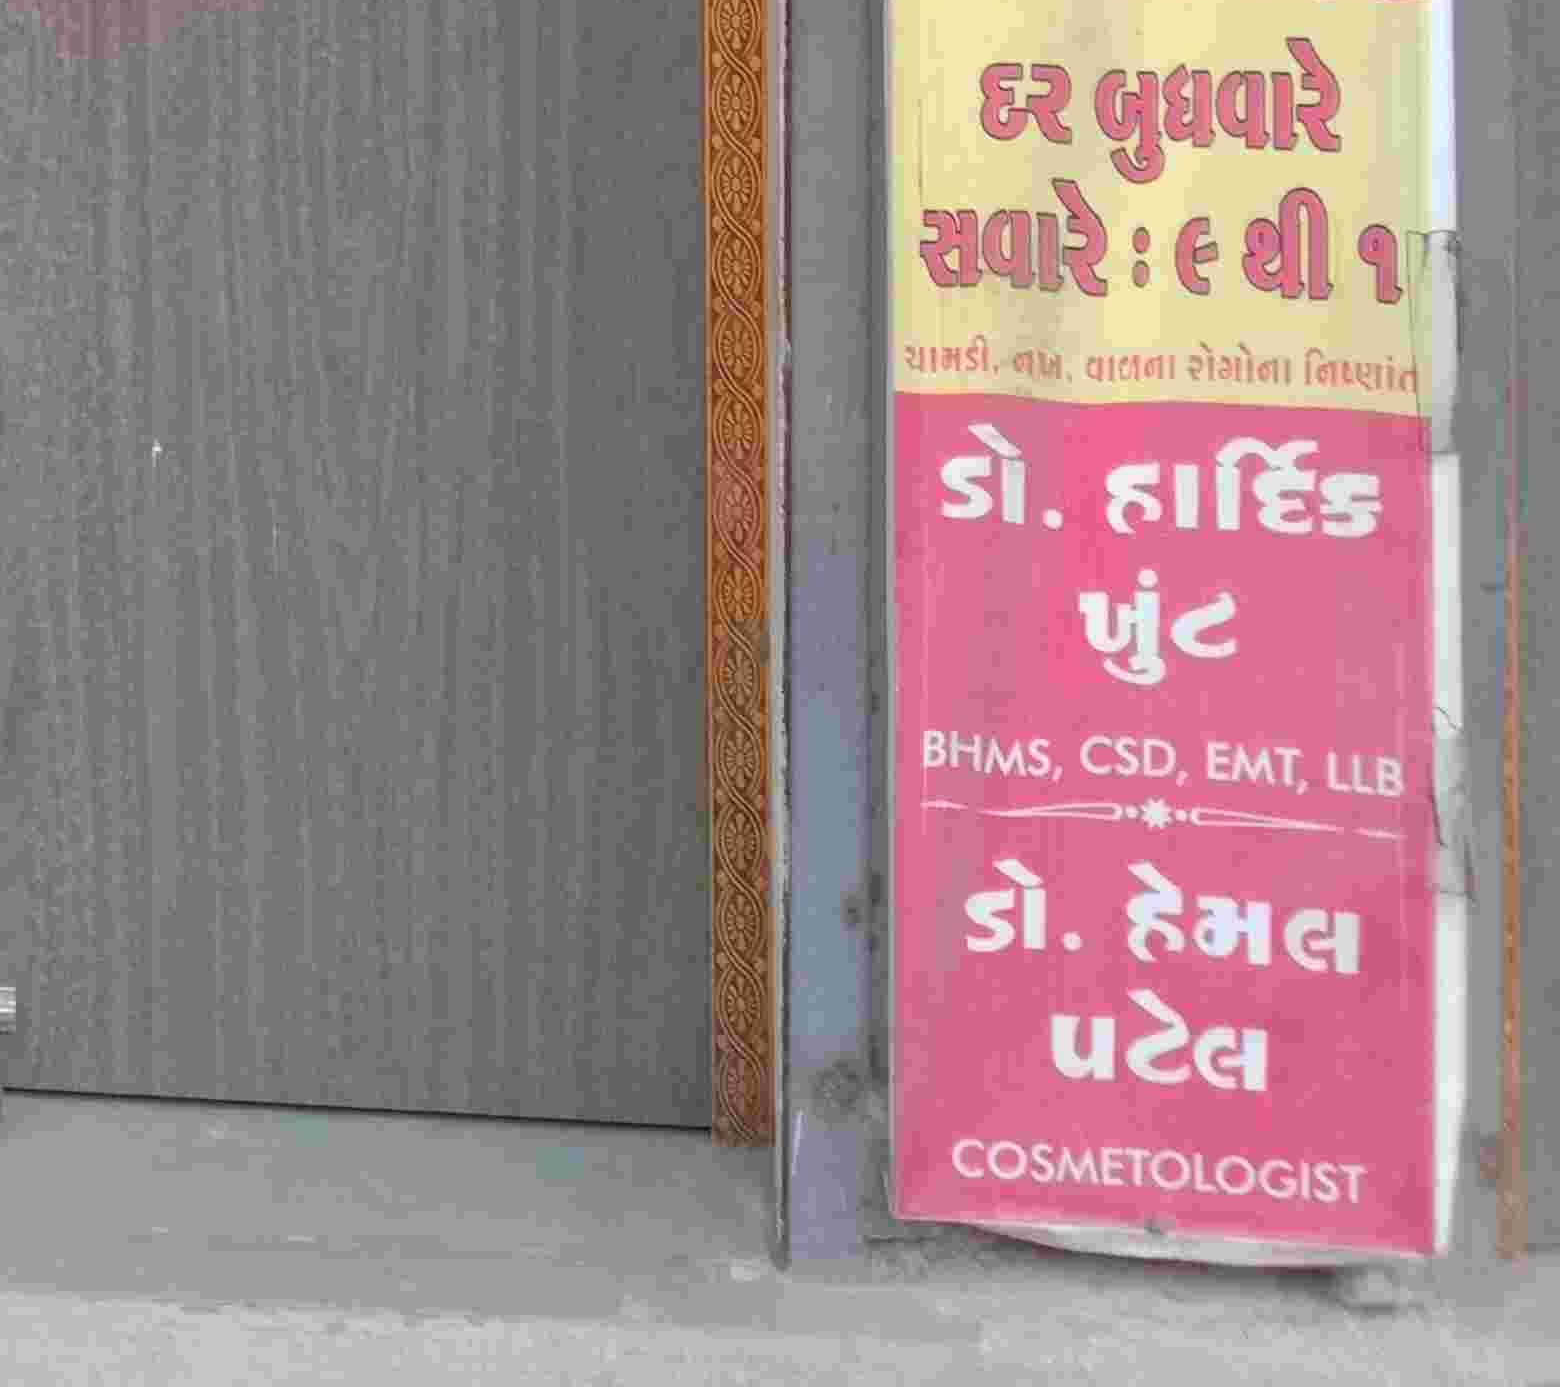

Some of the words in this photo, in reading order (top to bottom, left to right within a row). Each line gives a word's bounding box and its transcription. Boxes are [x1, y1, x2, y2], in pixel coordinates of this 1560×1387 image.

[979, 62, 1073, 145] દર
[1094, 36, 1343, 184] બુધવારે
[1241, 186, 1334, 301] થી
[1357, 223, 1404, 305] ૧
[939, 423, 1064, 529] ડો.
[1105, 436, 1383, 538] હાર્દિક
[1077, 568, 1238, 686] ખુંટ
[921, 730, 1064, 782] BHMS,
[1080, 736, 1189, 786] CSD,
[1206, 743, 1309, 795] EMT,
[1326, 752, 1406, 798] LLB
[964, 858, 1083, 953] ડો.
[1126, 860, 1362, 976] હેમલ
[1050, 989, 1269, 1093] પટેલ
[951, 1139, 1368, 1204] COSMETOLOGIST
